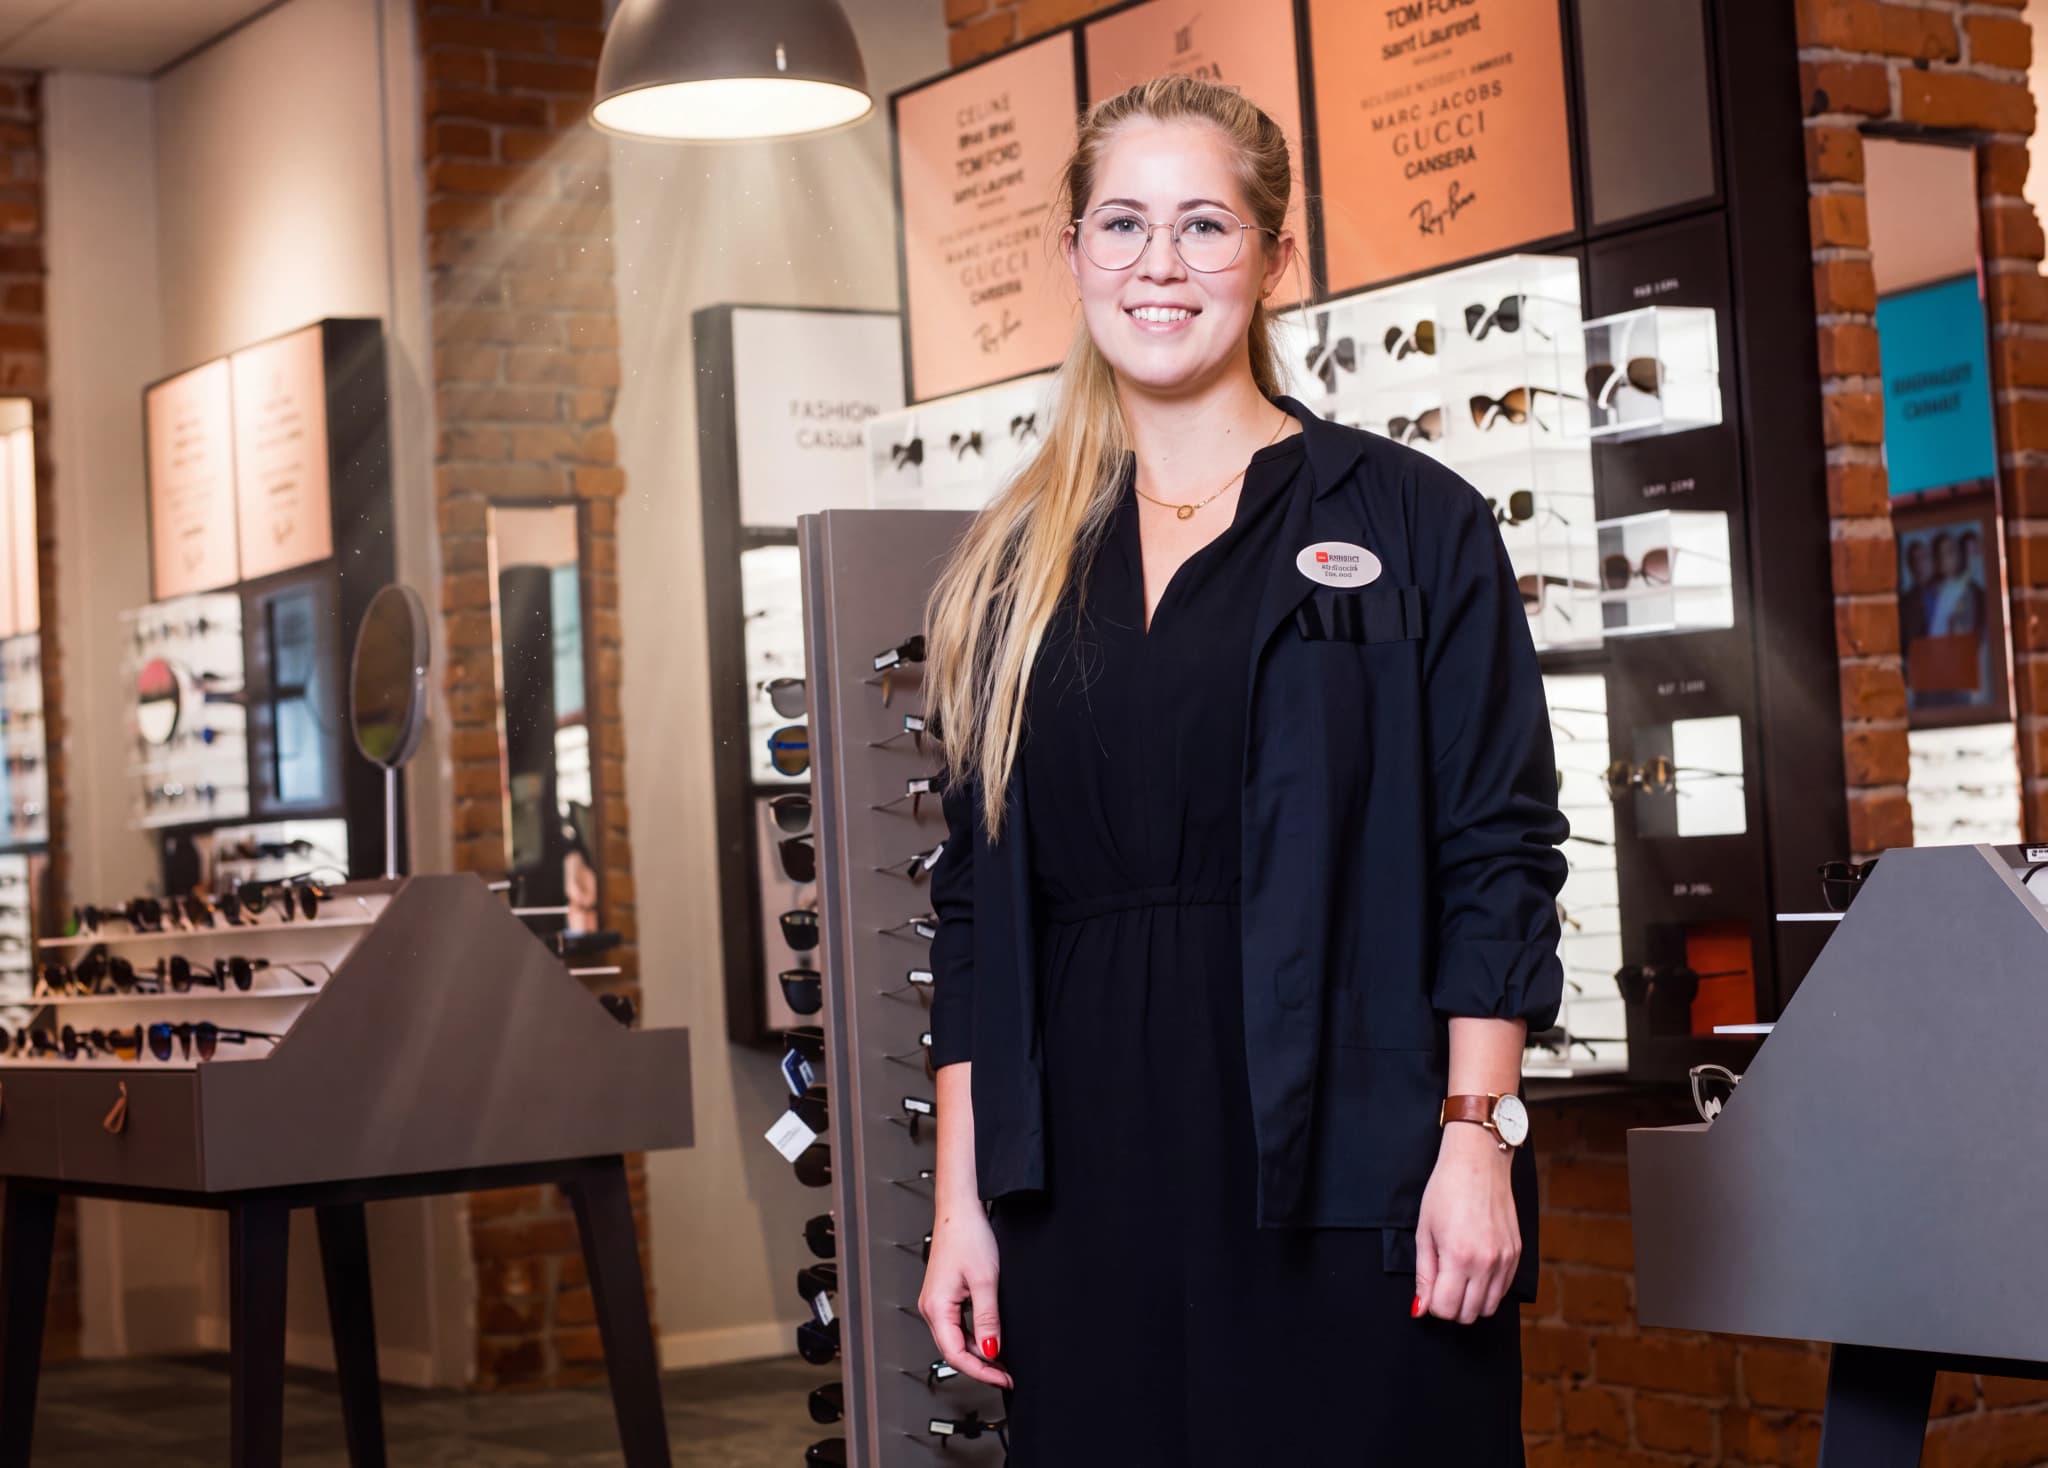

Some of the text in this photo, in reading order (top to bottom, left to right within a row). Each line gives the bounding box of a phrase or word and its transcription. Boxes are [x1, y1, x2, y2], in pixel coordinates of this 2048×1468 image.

[1386, 0, 1476, 31] TOM FO
[1371, 104, 1421, 132] MARC
[1429, 79, 1503, 118] JACOBS
[1392, 110, 1486, 157] GUCCI
[797, 429, 864, 450] CASUA
